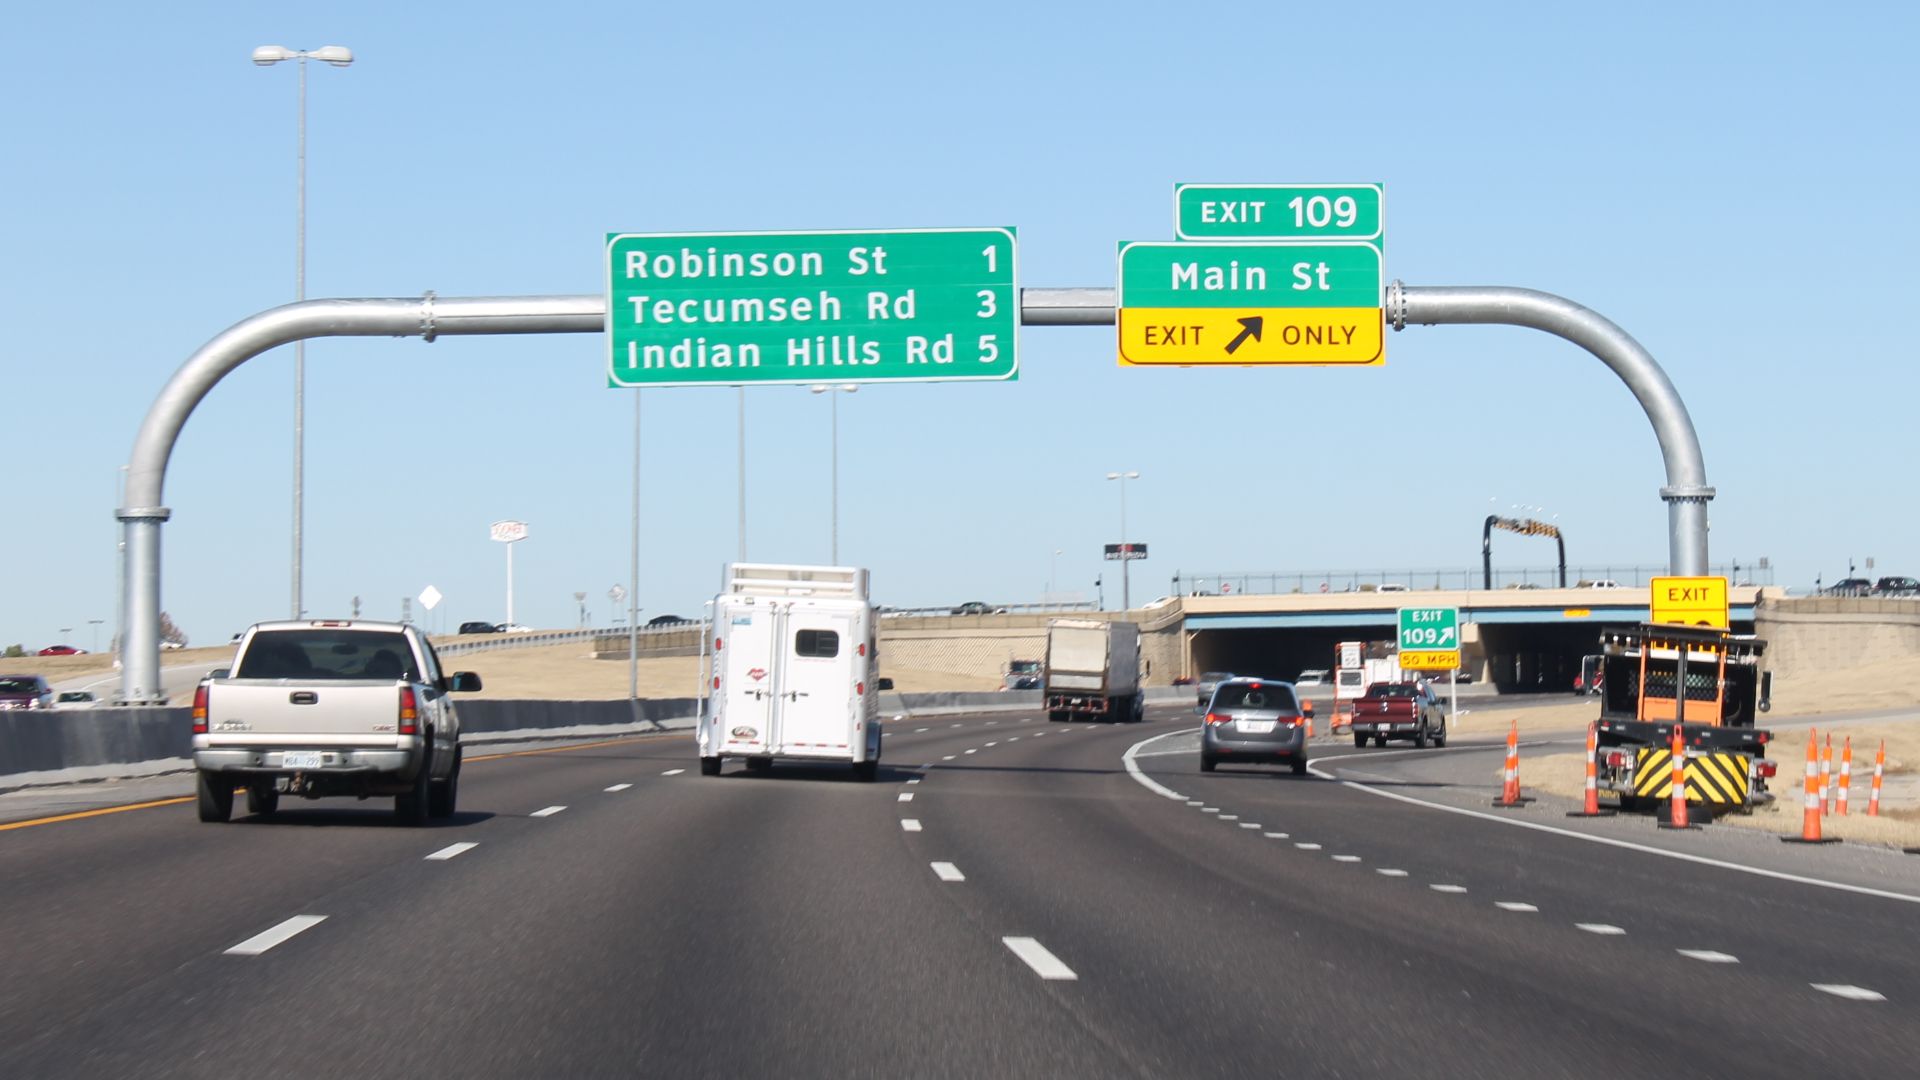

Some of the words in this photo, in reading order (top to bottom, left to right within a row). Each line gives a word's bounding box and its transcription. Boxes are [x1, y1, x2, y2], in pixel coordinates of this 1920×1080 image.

[1201, 201, 1266, 223] EXIT
[1288, 195, 1357, 228] 109
[625, 246, 823, 279] Robinson
[848, 245, 888, 276] St
[981, 244, 998, 273] 1
[1171, 260, 1267, 291] Main
[1292, 261, 1331, 291] St
[626, 290, 842, 324] Tecumseh
[867, 288, 916, 320] Rd
[975, 289, 998, 318] 3
[1144, 325, 1205, 346] EXIT
[1281, 325, 1357, 346] ONLY
[627, 337, 761, 369] Indian
[786, 335, 881, 367] Hills
[906, 333, 955, 364] Rd
[977, 334, 999, 363] 5
[1668, 587, 1709, 601] EXIT
[1412, 610, 1443, 622] EXIT
[1402, 627, 1437, 644] 109
[1427, 655, 1456, 665] MPH
